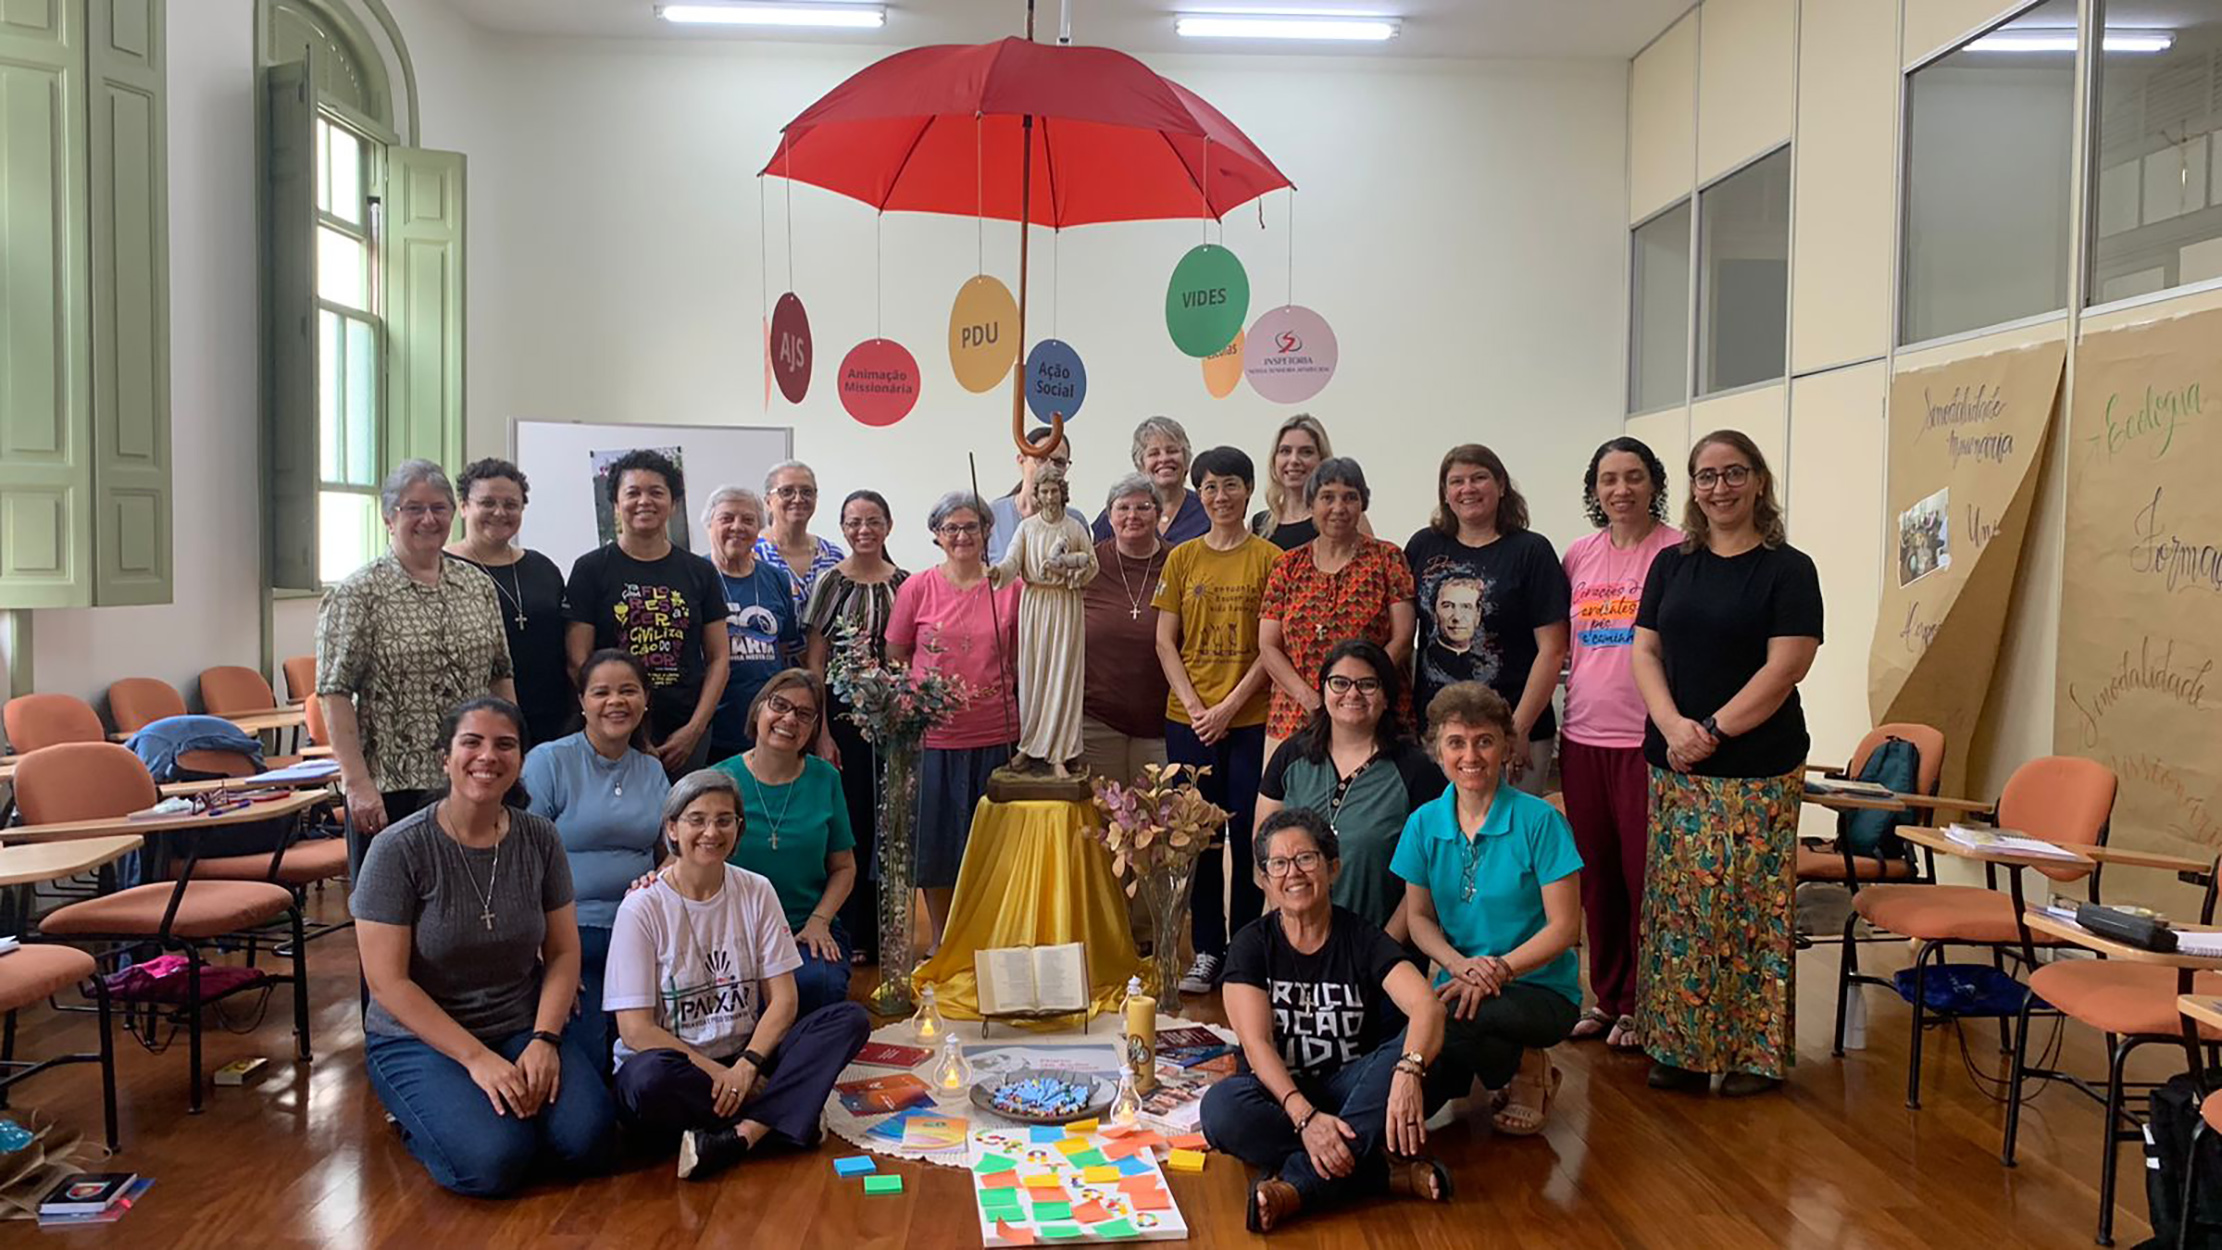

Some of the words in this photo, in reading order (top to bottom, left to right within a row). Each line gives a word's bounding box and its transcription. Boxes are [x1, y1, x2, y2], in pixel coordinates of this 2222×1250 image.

[1182, 288, 1227, 308] VIDES
[961, 321, 999, 349] PDU
[779, 331, 805, 372] AJS
[848, 368, 908, 382] Animação
[1038, 361, 1071, 380] Ação
[844, 380, 913, 394] Missionária
[1036, 379, 1075, 398] Social
[2101, 383, 2203, 460] Ecologia
[1267, 978, 1364, 1007] RTICU
